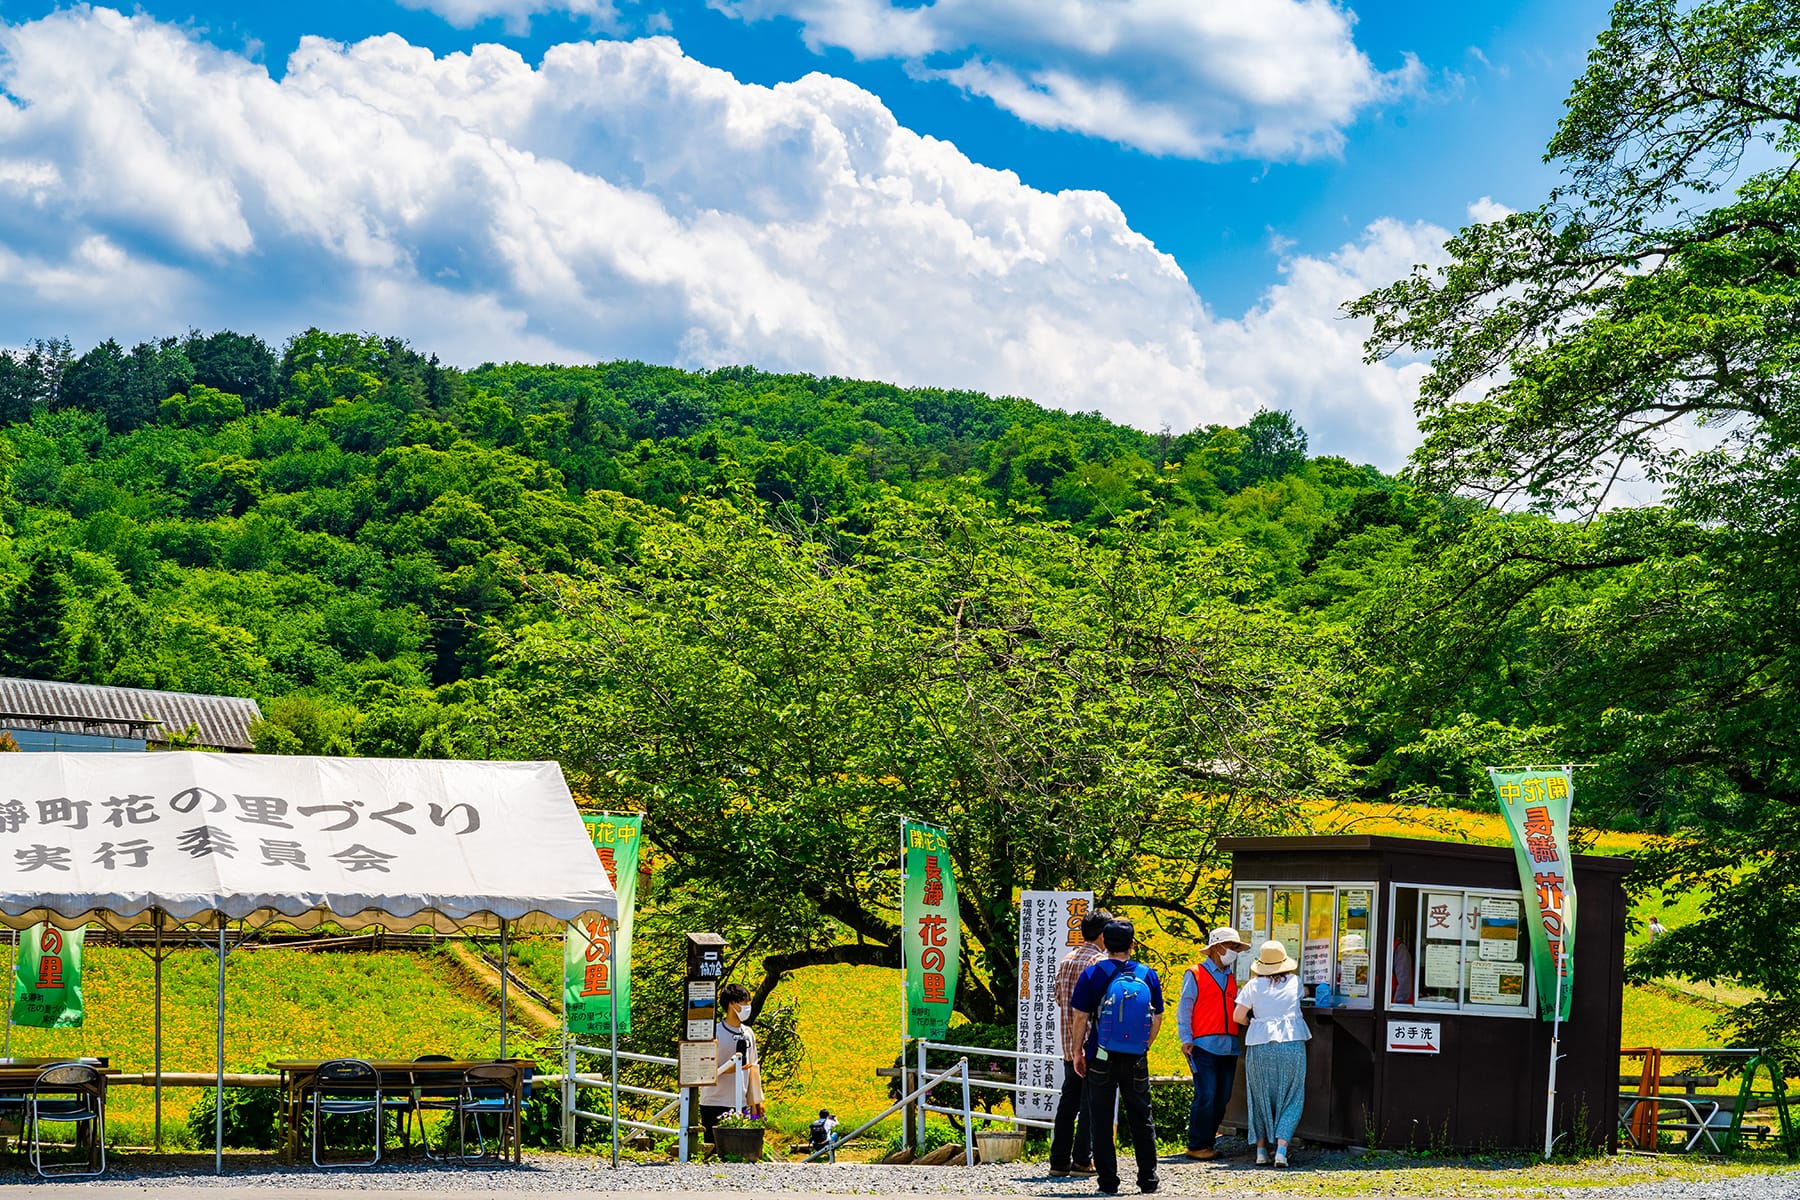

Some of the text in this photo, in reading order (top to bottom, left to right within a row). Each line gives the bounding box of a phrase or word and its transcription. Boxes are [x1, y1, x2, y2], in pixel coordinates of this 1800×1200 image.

[14, 825, 399, 872] 実行委員会
[909, 829, 948, 853] 開花中
[1065, 898, 1089, 951] 花の里
[1429, 904, 1480, 930] 受付
[36, 921, 64, 988] の里
[918, 914, 949, 1004] 花の里
[571, 1011, 612, 1022] 花の里づく
[1043, 899, 1058, 1112] ハナビシソウは日が当たると開き、天不良や夕方
[587, 1021, 626, 1031] 実行委会
[1395, 1026, 1433, 1041] お手洗
